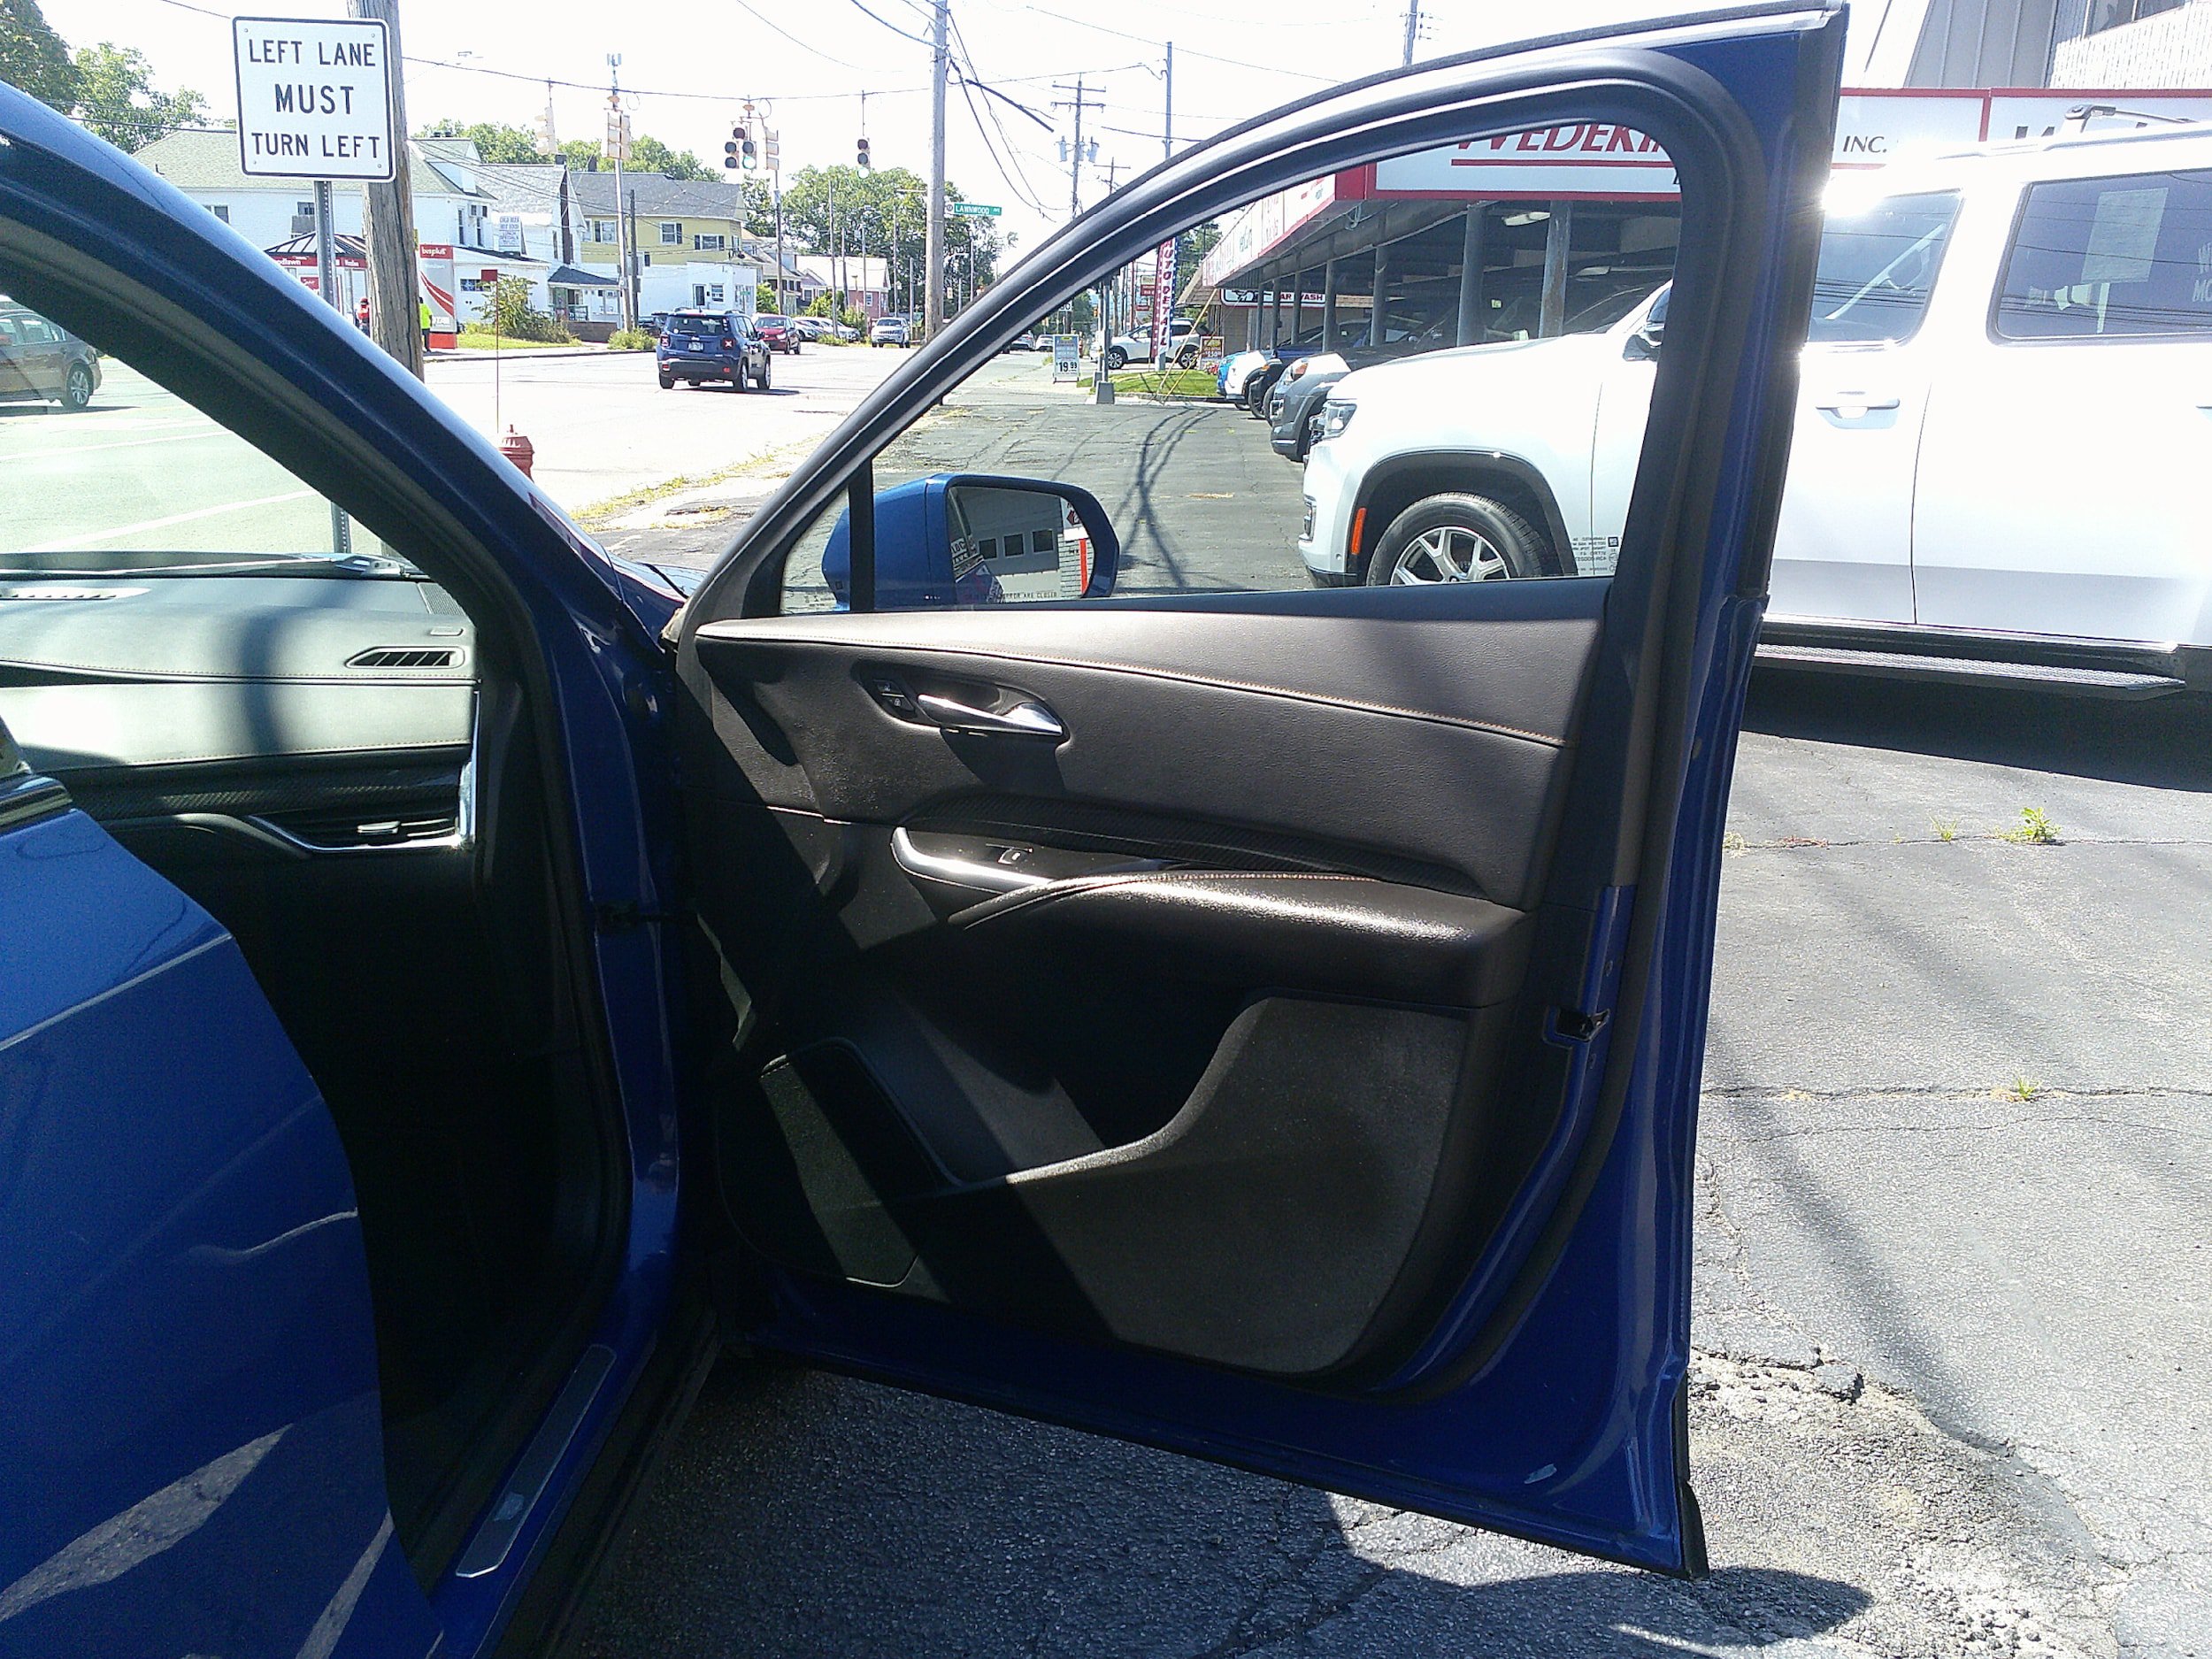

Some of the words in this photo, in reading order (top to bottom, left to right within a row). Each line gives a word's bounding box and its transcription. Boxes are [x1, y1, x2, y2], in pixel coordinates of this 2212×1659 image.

[249, 39, 303, 64] LEFT
[318, 42, 376, 66] LANE
[274, 83, 354, 115] MUST
[251, 133, 309, 156] TURN
[321, 134, 380, 158] LEFT
[1842, 135, 1888, 153] INC.
[955, 204, 990, 214] LAWNWOOD
[1160, 286, 1171, 346] DETAIL
